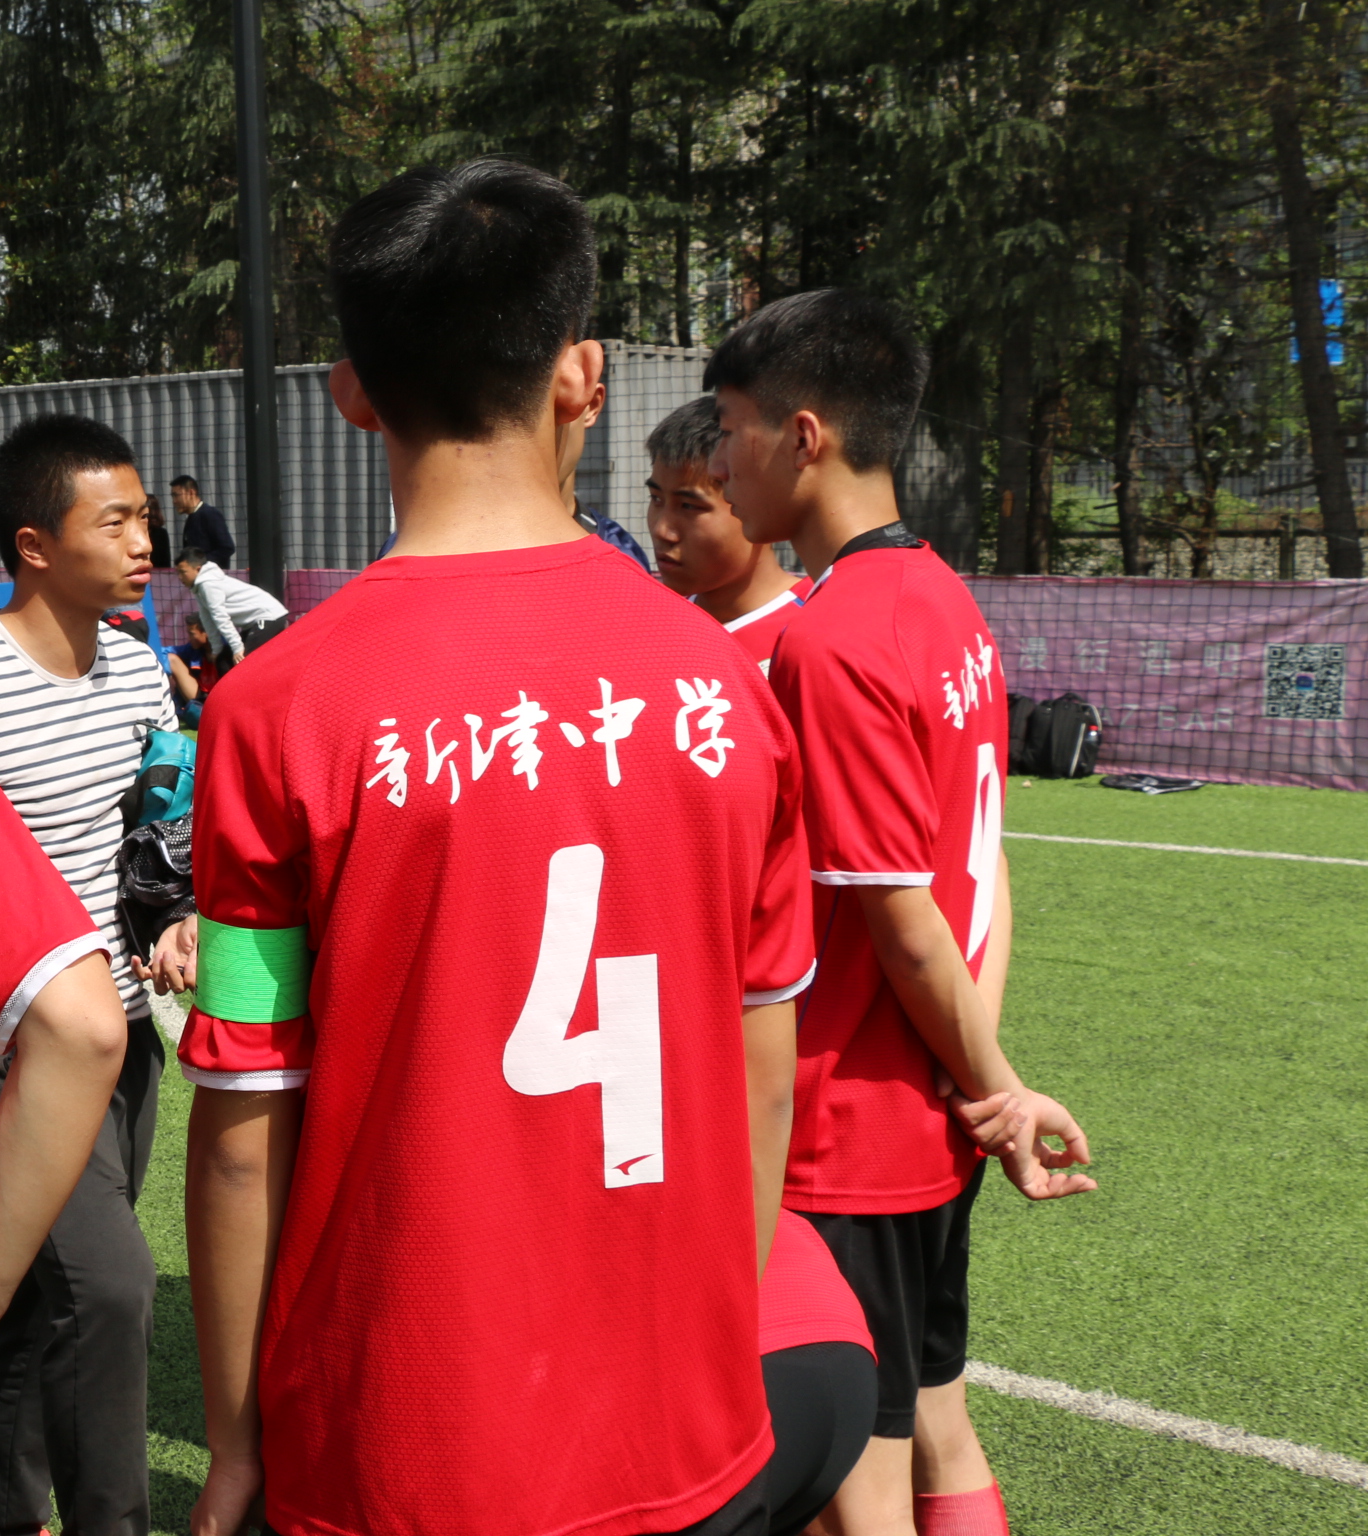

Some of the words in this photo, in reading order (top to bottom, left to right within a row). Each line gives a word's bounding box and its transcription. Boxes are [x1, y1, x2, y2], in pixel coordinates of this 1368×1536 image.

[884, 522, 906, 537] NIKE
[365, 677, 735, 808] 新津中学
[502, 843, 664, 1189] 4
